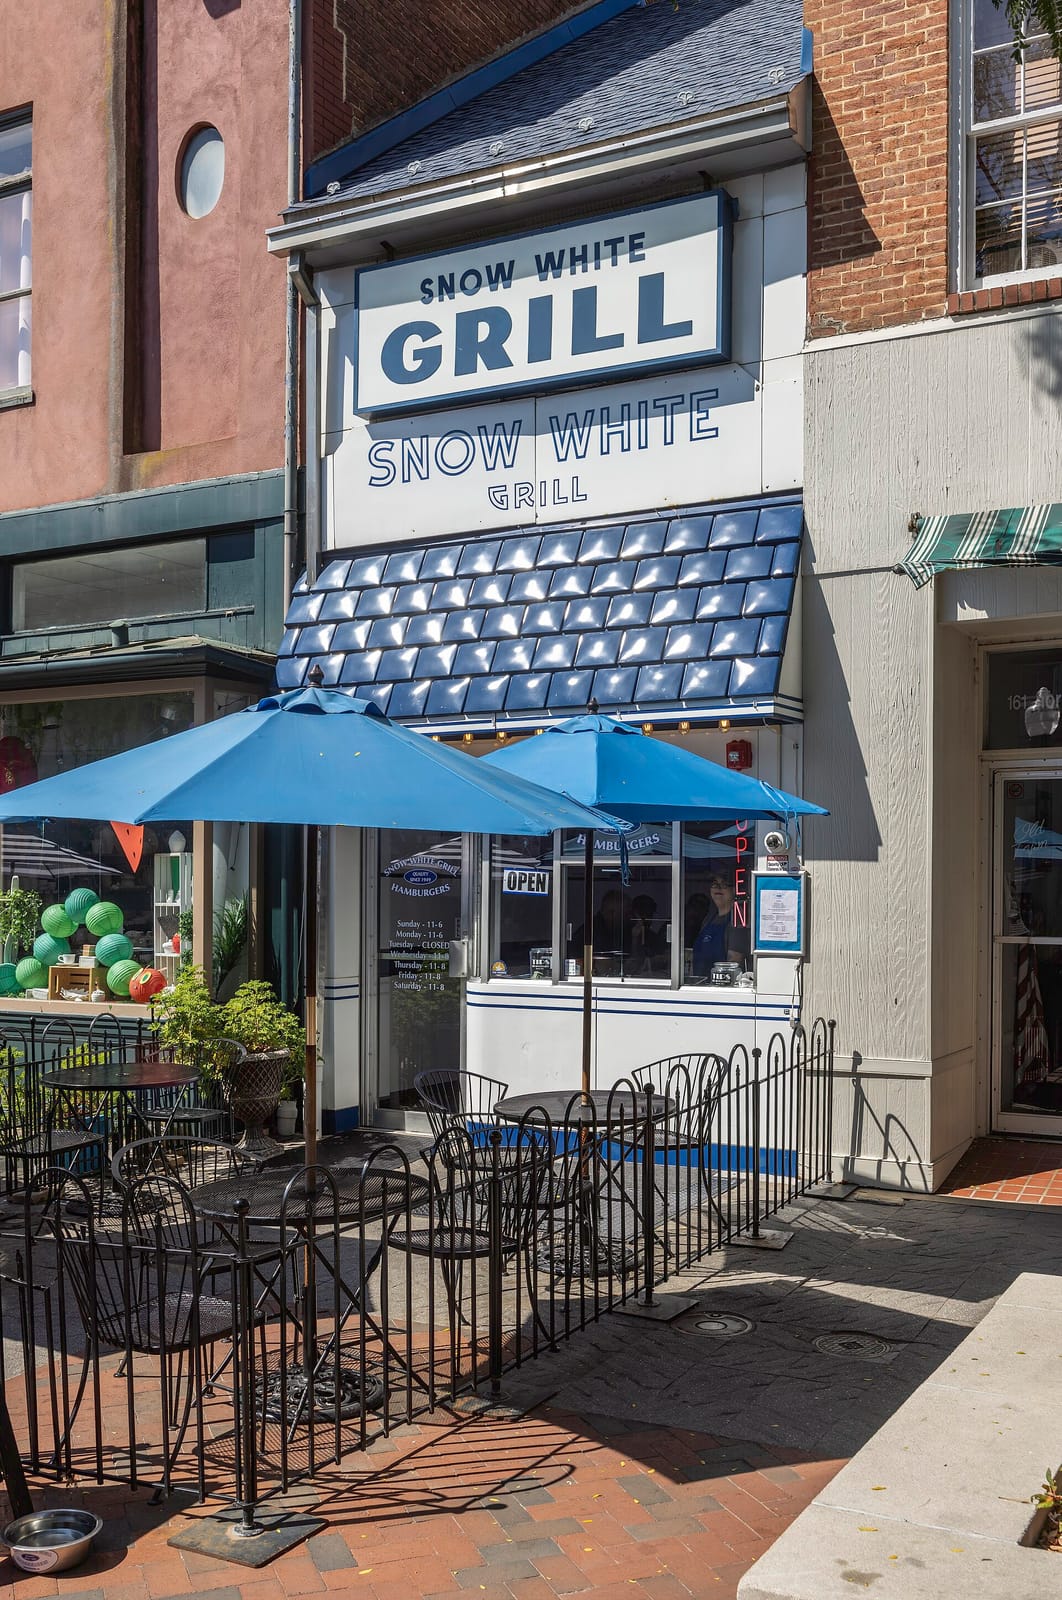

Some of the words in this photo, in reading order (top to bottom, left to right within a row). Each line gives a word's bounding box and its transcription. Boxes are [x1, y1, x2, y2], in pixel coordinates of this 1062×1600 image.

[420, 259, 515, 305] SNOW
[534, 231, 646, 282] WHITE
[380, 271, 693, 385] GRILL
[368, 419, 522, 488] SNOW
[549, 388, 719, 462] WHITE
[487, 476, 588, 510] GRILL
[576, 832, 660, 851] HMBUGERS
[384, 859, 409, 877] SNOW
[409, 855, 435, 865] WHITE
[391, 883, 451, 897] HAMBURGERS
[507, 871, 547, 893] OPEN
[397, 920, 420, 930] Sunday
[427, 920, 443, 929] 11-6
[395, 930, 421, 941] Monday
[428, 931, 444, 939] 11-6
[389, 940, 414, 951] Tuesday
[421, 941, 450, 949] CLOSED
[394, 960, 423, 971] Thursday
[429, 962, 446, 970] 11-8
[398, 970, 418, 981] Friday
[393, 981, 421, 992] Saturday
[428, 983, 445, 991] 11-8
